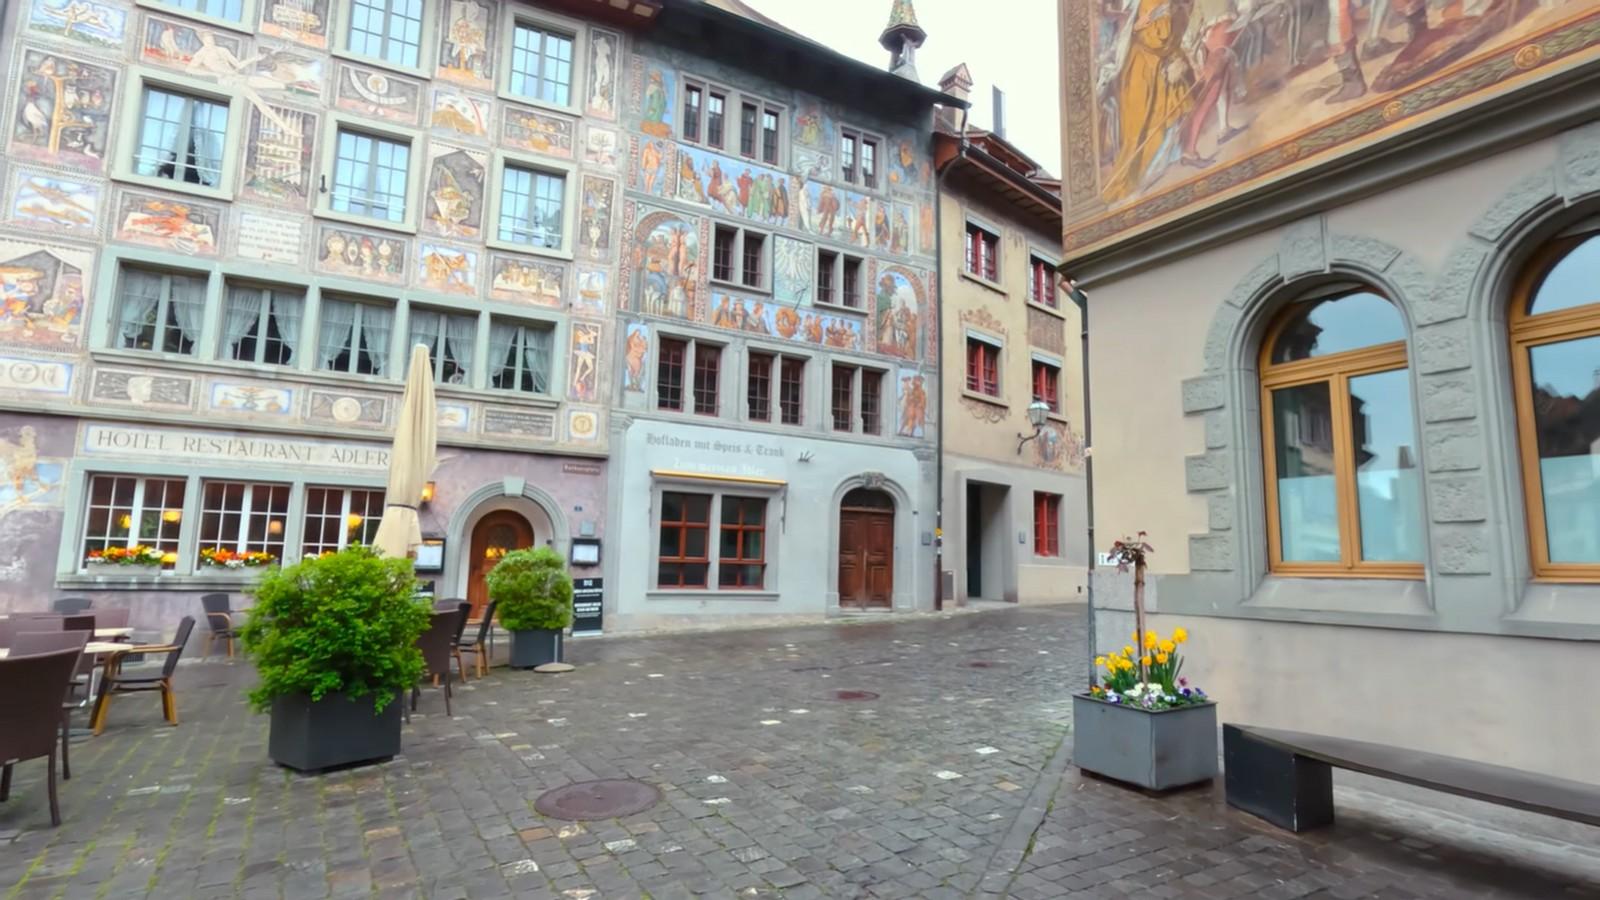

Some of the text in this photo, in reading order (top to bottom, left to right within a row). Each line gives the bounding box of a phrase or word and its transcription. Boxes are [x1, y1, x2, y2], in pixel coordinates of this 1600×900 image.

[97, 430, 389, 466] HOTEL RESTAURANT ADLER
[646, 433, 691, 448] Hofladen
[713, 440, 741, 453] Speis
[755, 444, 785, 457] Trank
